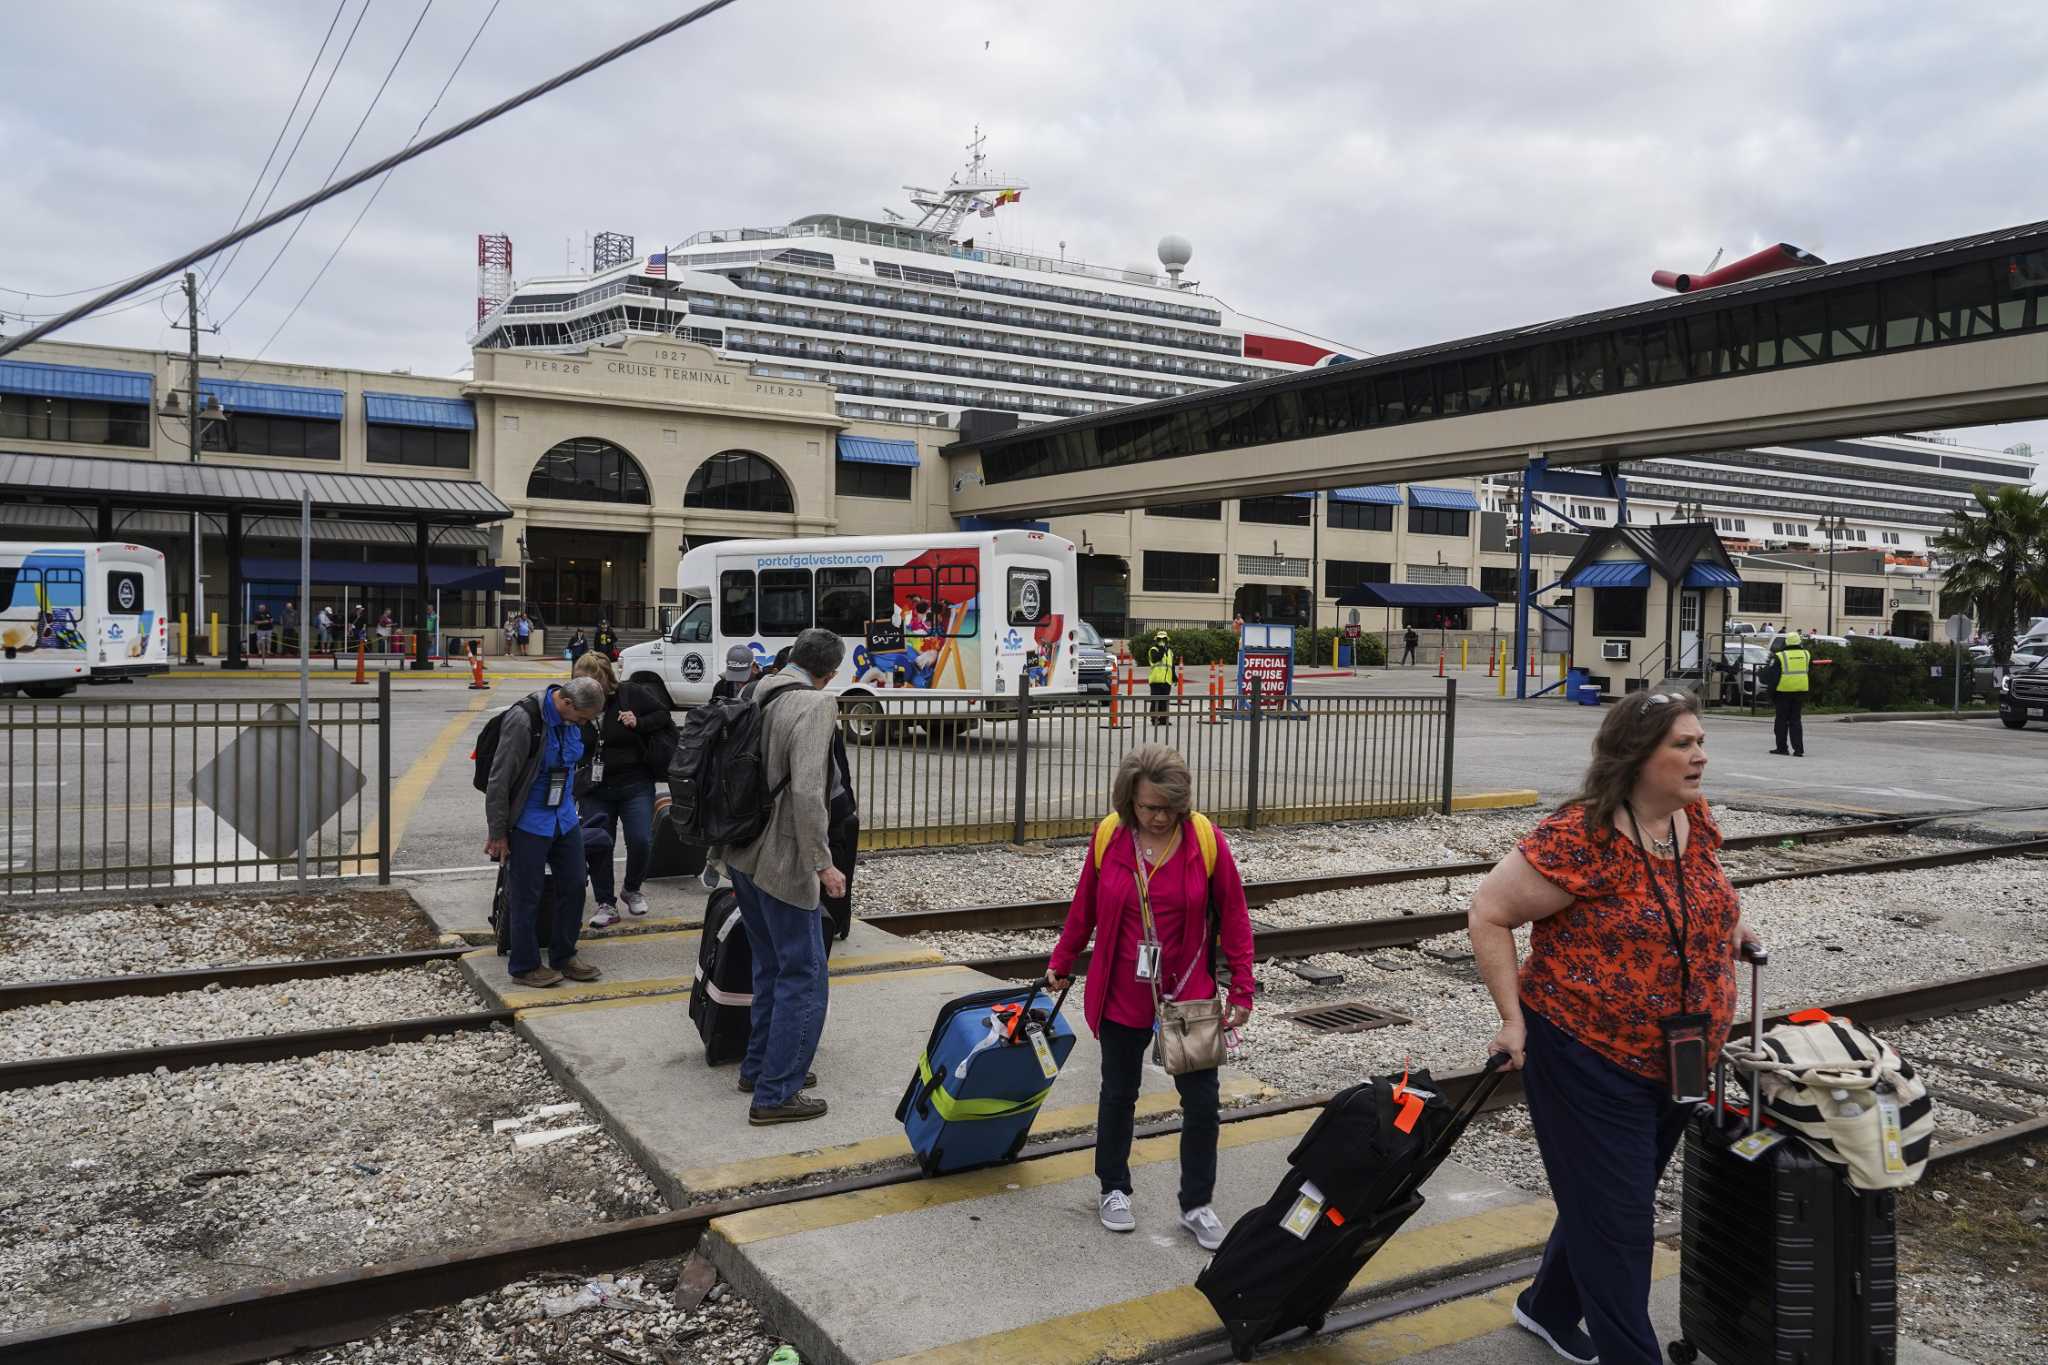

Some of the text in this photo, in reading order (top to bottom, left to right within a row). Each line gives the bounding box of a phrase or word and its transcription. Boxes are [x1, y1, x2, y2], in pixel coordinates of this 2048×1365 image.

[525, 360, 580, 374] PIER 26
[607, 362, 730, 385] CRUISE TERMINAL
[756, 384, 803, 398] PIER 23
[757, 554, 883, 568] portofgalveston.com
